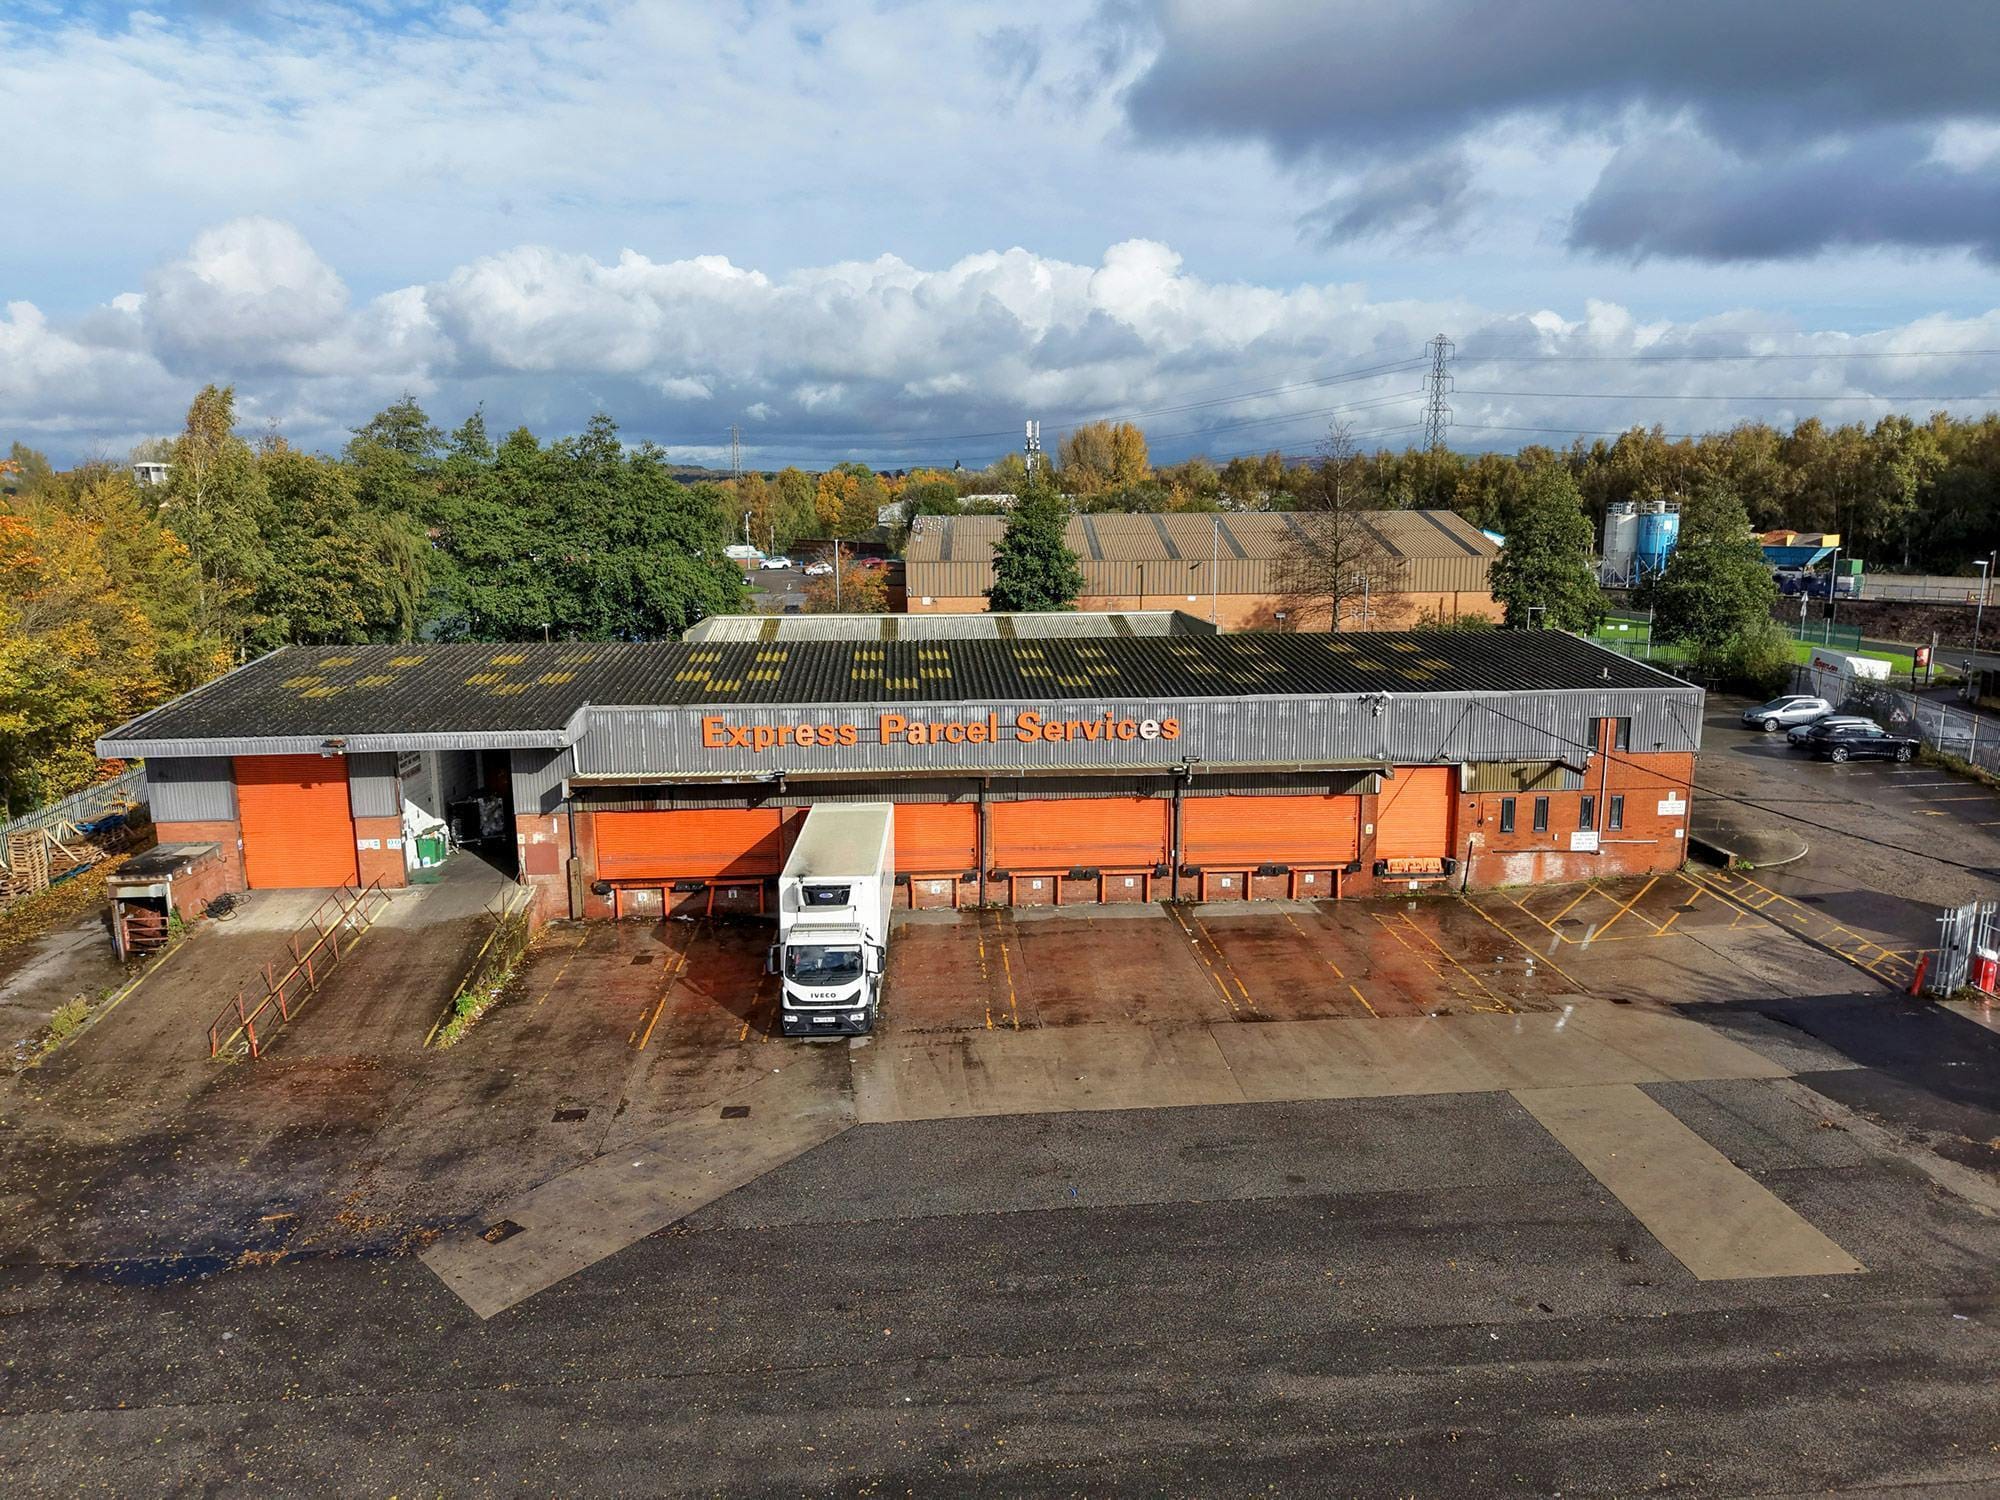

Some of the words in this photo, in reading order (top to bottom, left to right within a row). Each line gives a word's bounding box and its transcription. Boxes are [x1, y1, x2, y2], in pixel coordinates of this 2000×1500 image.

[702, 716, 857, 752] Express
[880, 712, 998, 746] Parcel
[1015, 711, 1180, 742] Services
